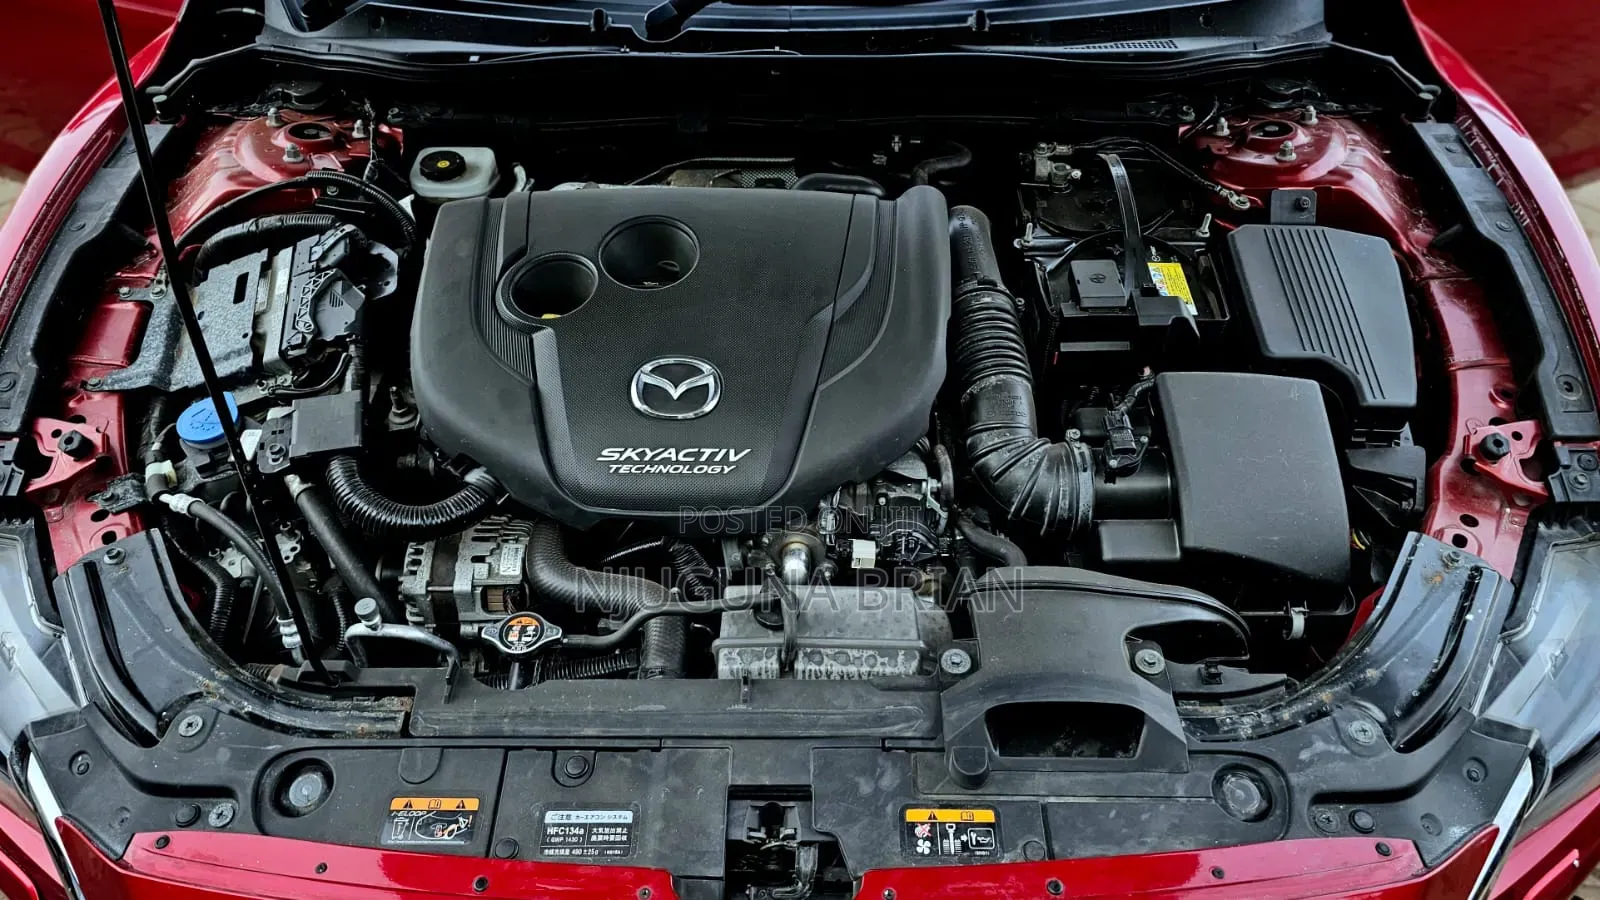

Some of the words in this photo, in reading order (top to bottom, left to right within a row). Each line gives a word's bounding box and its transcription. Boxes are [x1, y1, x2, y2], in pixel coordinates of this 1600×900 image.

[596, 447, 752, 461] SKYACTIV
[608, 464, 737, 474] TECHNOLOGY
[546, 826, 585, 835] HFC134a
